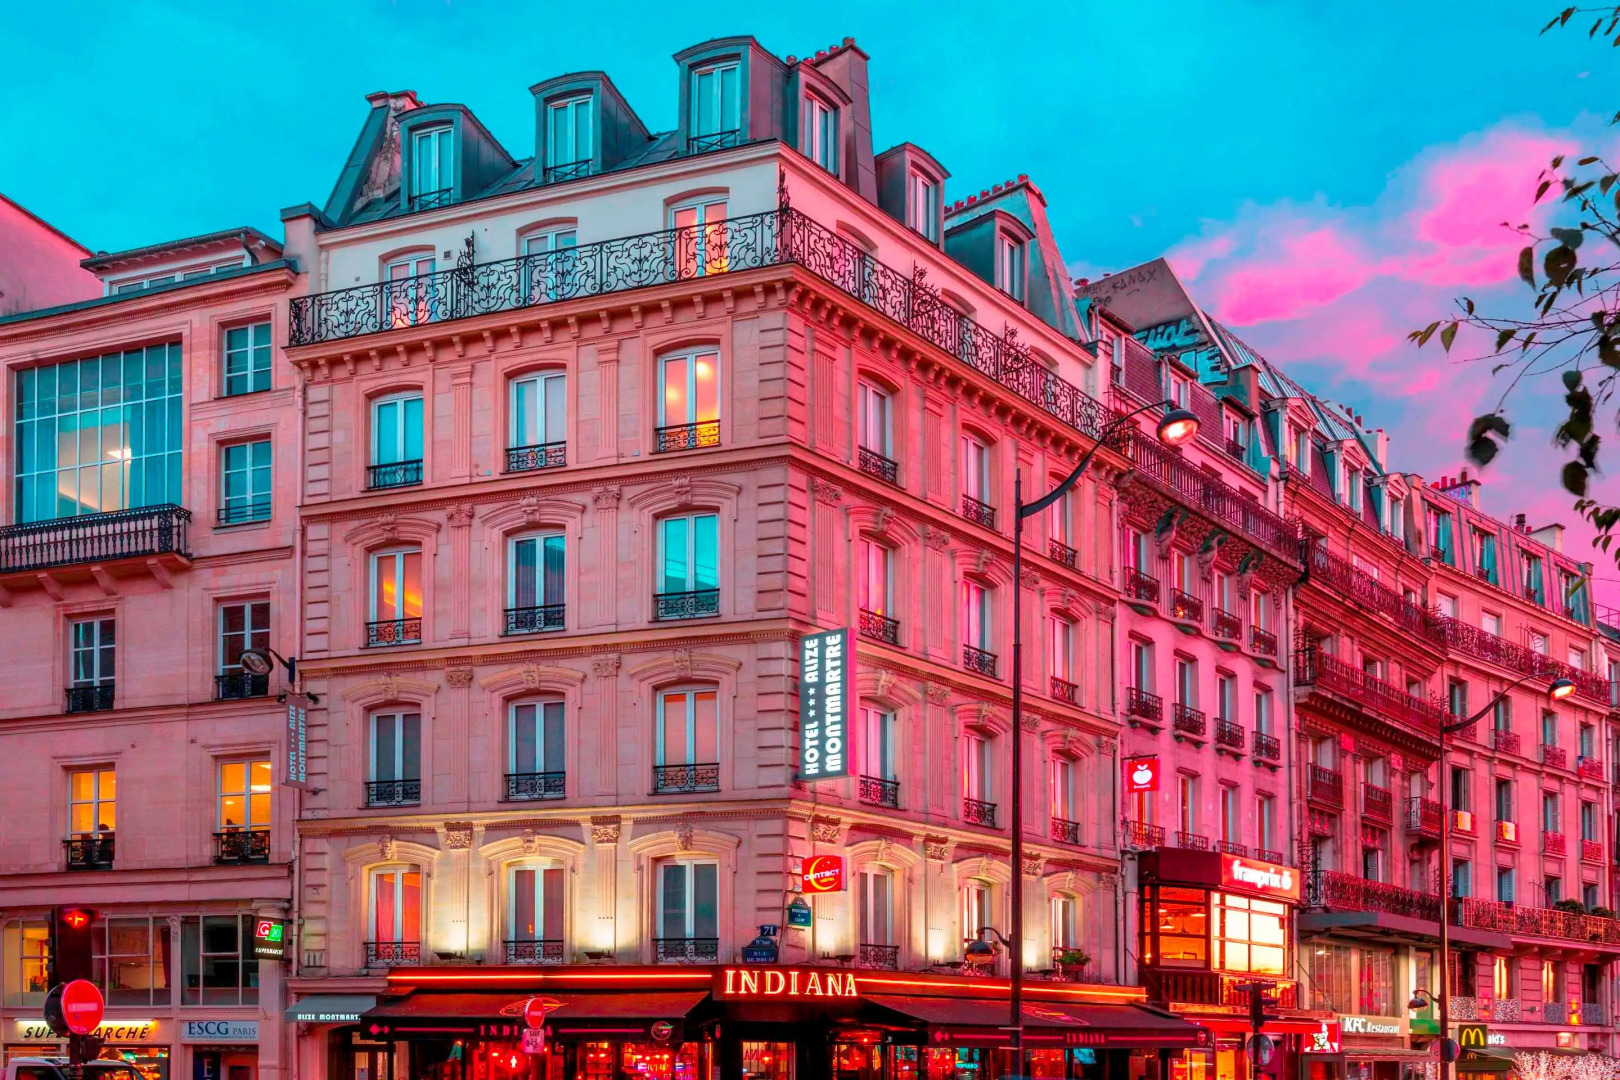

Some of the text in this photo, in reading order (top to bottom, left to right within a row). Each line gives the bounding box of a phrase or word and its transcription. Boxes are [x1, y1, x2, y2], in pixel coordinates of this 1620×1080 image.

[805, 638, 819, 774] HOTEL ALIZE
[825, 633, 841, 772] MONTMARTRE
[298, 707, 306, 783] MONTMARTRE
[763, 926, 774, 936] 71
[725, 969, 858, 997] INDIANA
[187, 1021, 257, 1036] ESCG PARIS
[479, 1025, 553, 1036] INDIA
[1343, 1016, 1366, 1032] KFC
[1066, 1033, 1106, 1044] INDIANA
